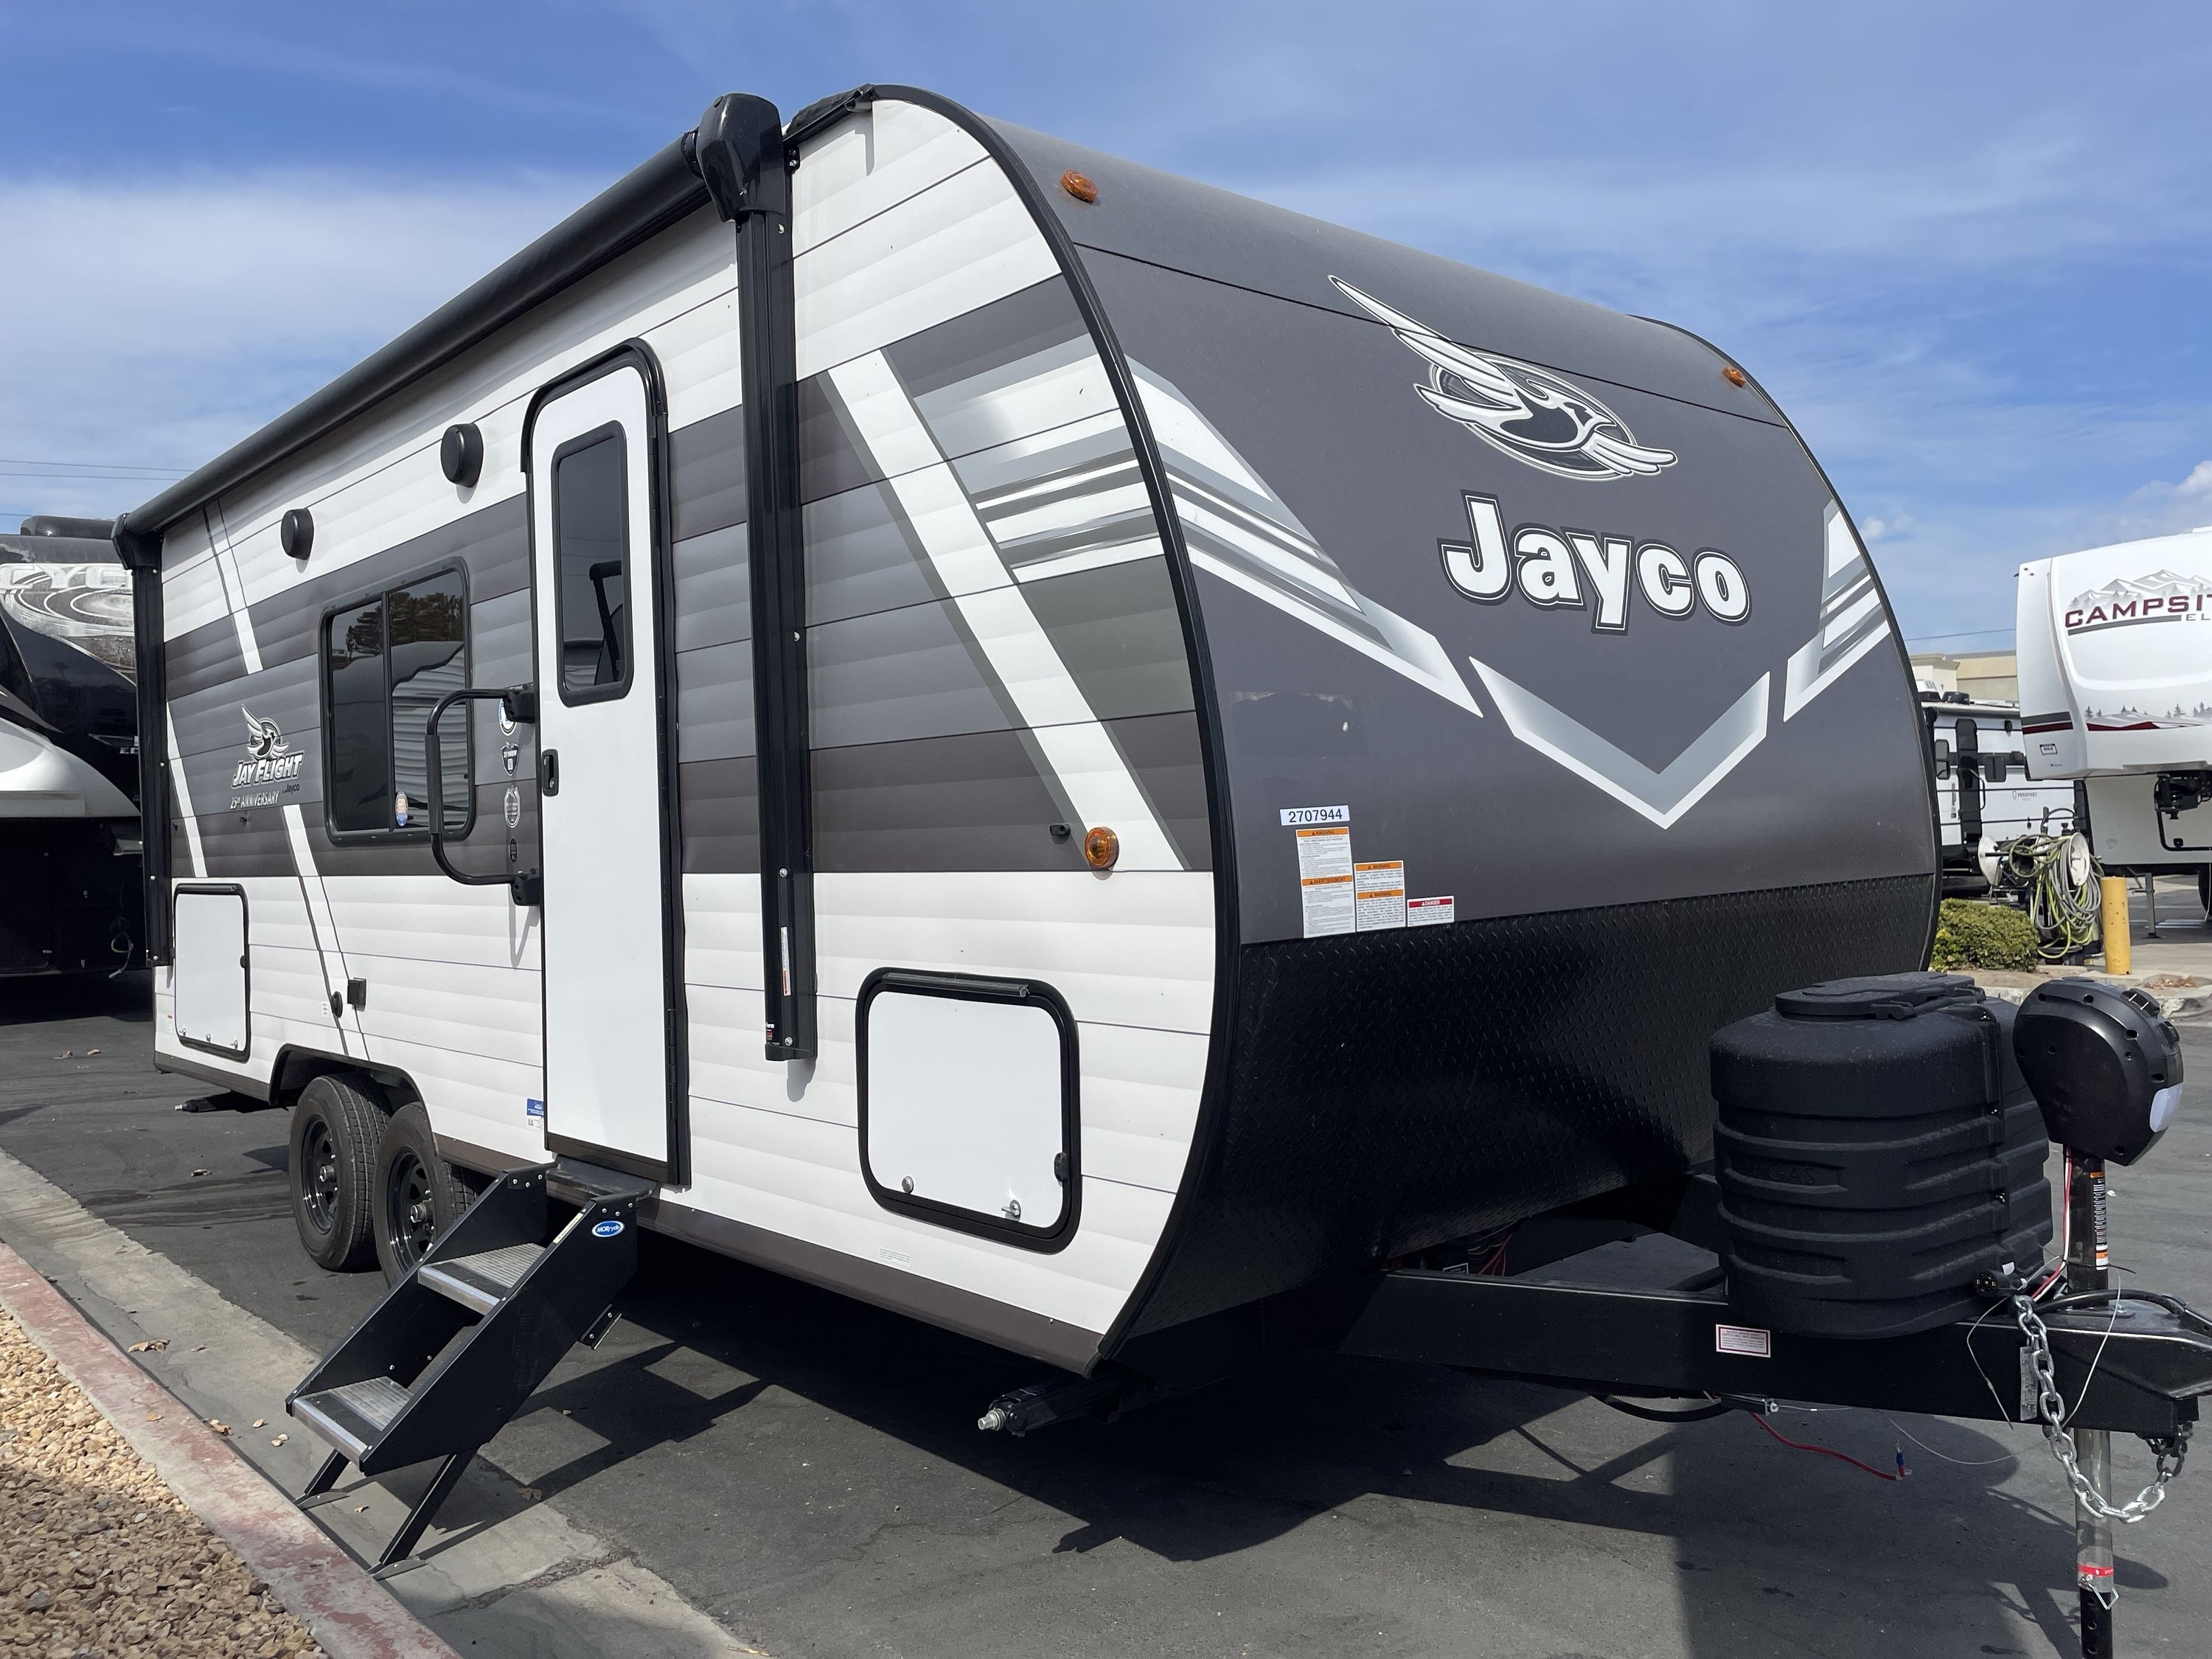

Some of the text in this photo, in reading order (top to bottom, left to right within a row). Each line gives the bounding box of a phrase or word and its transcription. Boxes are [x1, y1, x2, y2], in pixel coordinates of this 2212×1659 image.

[1438, 491, 1751, 634] Jayco
[2065, 594, 2212, 628] CAMPSI
[232, 754, 304, 787] JAY FLIGHT
[240, 790, 280, 808] ANNIVERSARY
[285, 782, 300, 795] Jayco
[1287, 808, 1343, 824] 2707944
